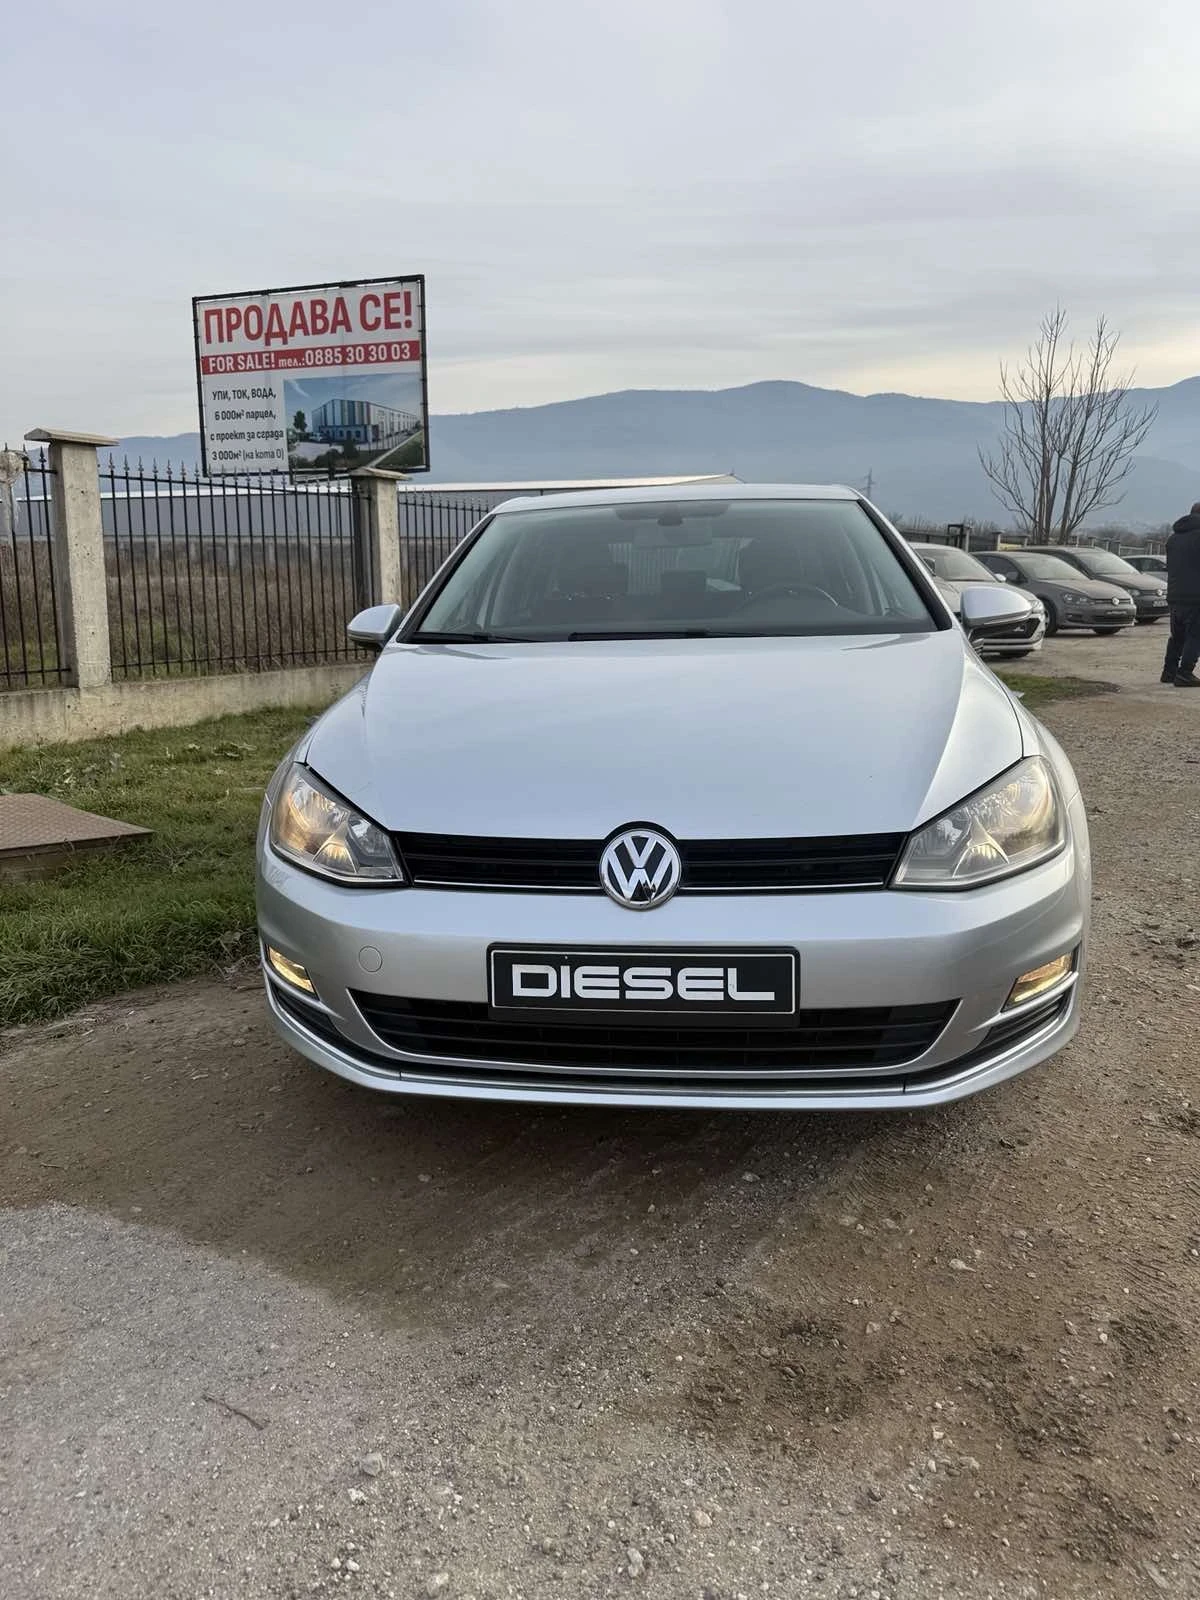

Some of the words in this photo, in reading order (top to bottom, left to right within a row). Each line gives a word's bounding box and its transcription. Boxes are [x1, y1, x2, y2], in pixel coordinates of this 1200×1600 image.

[204, 297, 352, 346] ПРОДАВА
[359, 291, 413, 332] СЕ!
[208, 356, 234, 373] FOR
[237, 356, 275, 370] SALE!
[346, 346, 365, 364] 30
[368, 345, 387, 361] 30
[391, 343, 410, 360] 03
[212, 390, 231, 401] УПИ,
[232, 390, 250, 400] ТОК,
[251, 388, 276, 399] ВОДА,
[215, 411, 220, 420] 6
[246, 410, 276, 420] парцел,
[216, 430, 245, 442] проект
[247, 432, 255, 441] за
[257, 431, 284, 440] сграда
[212, 451, 217, 460] 3
[243, 450, 253, 461] (на
[255, 450, 275, 459] кота
[512, 963, 775, 1001] DIESEL
